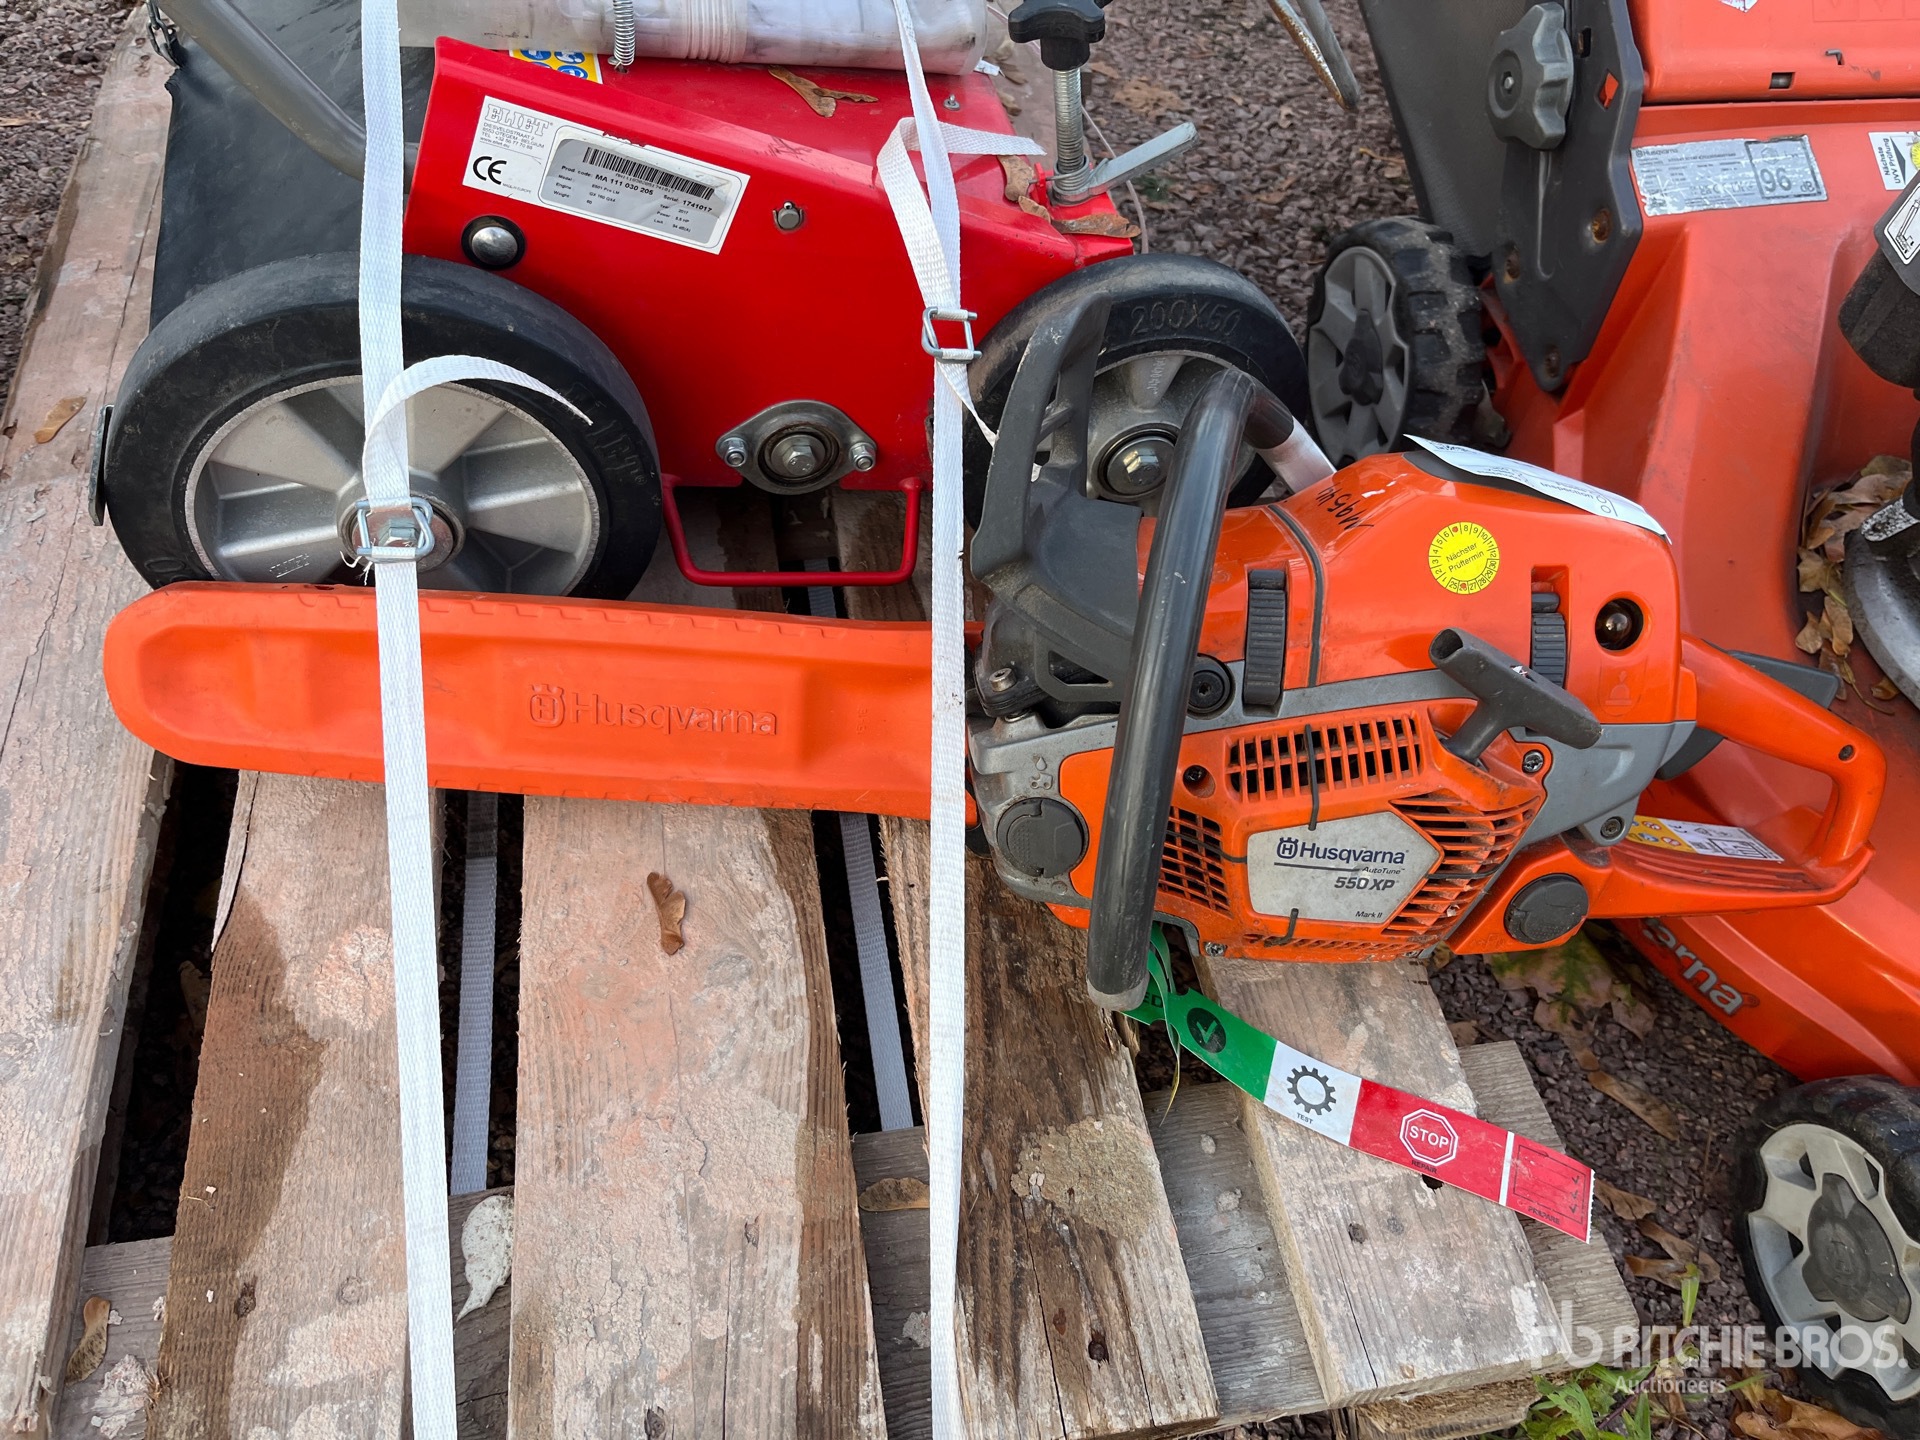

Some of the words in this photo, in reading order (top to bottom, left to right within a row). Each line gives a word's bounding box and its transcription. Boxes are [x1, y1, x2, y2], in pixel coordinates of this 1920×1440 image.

[485, 104, 549, 136] ELIET
[484, 122, 531, 140] DIESVELDSTRAAT
[520, 138, 545, 149] BELGIUM
[1883, 138, 1896, 168] Prüfung
[1878, 146, 1890, 176] Nächste
[595, 174, 608, 183] MA
[610, 178, 623, 187] 111
[624, 182, 639, 191] 030
[640, 187, 654, 196] 205
[1759, 167, 1793, 193] 96
[1891, 168, 1901, 184] UVV
[1800, 180, 1816, 193] dB
[682, 199, 713, 213] 1741017
[1446, 542, 1478, 563] Nächster
[1448, 550, 1485, 573] Prüftermin
[570, 692, 777, 735] Husqvarna
[1299, 842, 1406, 864] Husqvarna
[1361, 866, 1401, 875] AutoTune
[1334, 877, 1369, 890] 550
[1369, 879, 1395, 891] XP
[1355, 910, 1376, 919] Mark
[1296, 1112, 1314, 1124] TEST
[1409, 1125, 1449, 1149] STOP
[1411, 1159, 1437, 1174] REPAIR
[1527, 1205, 1560, 1225] PREPARE
